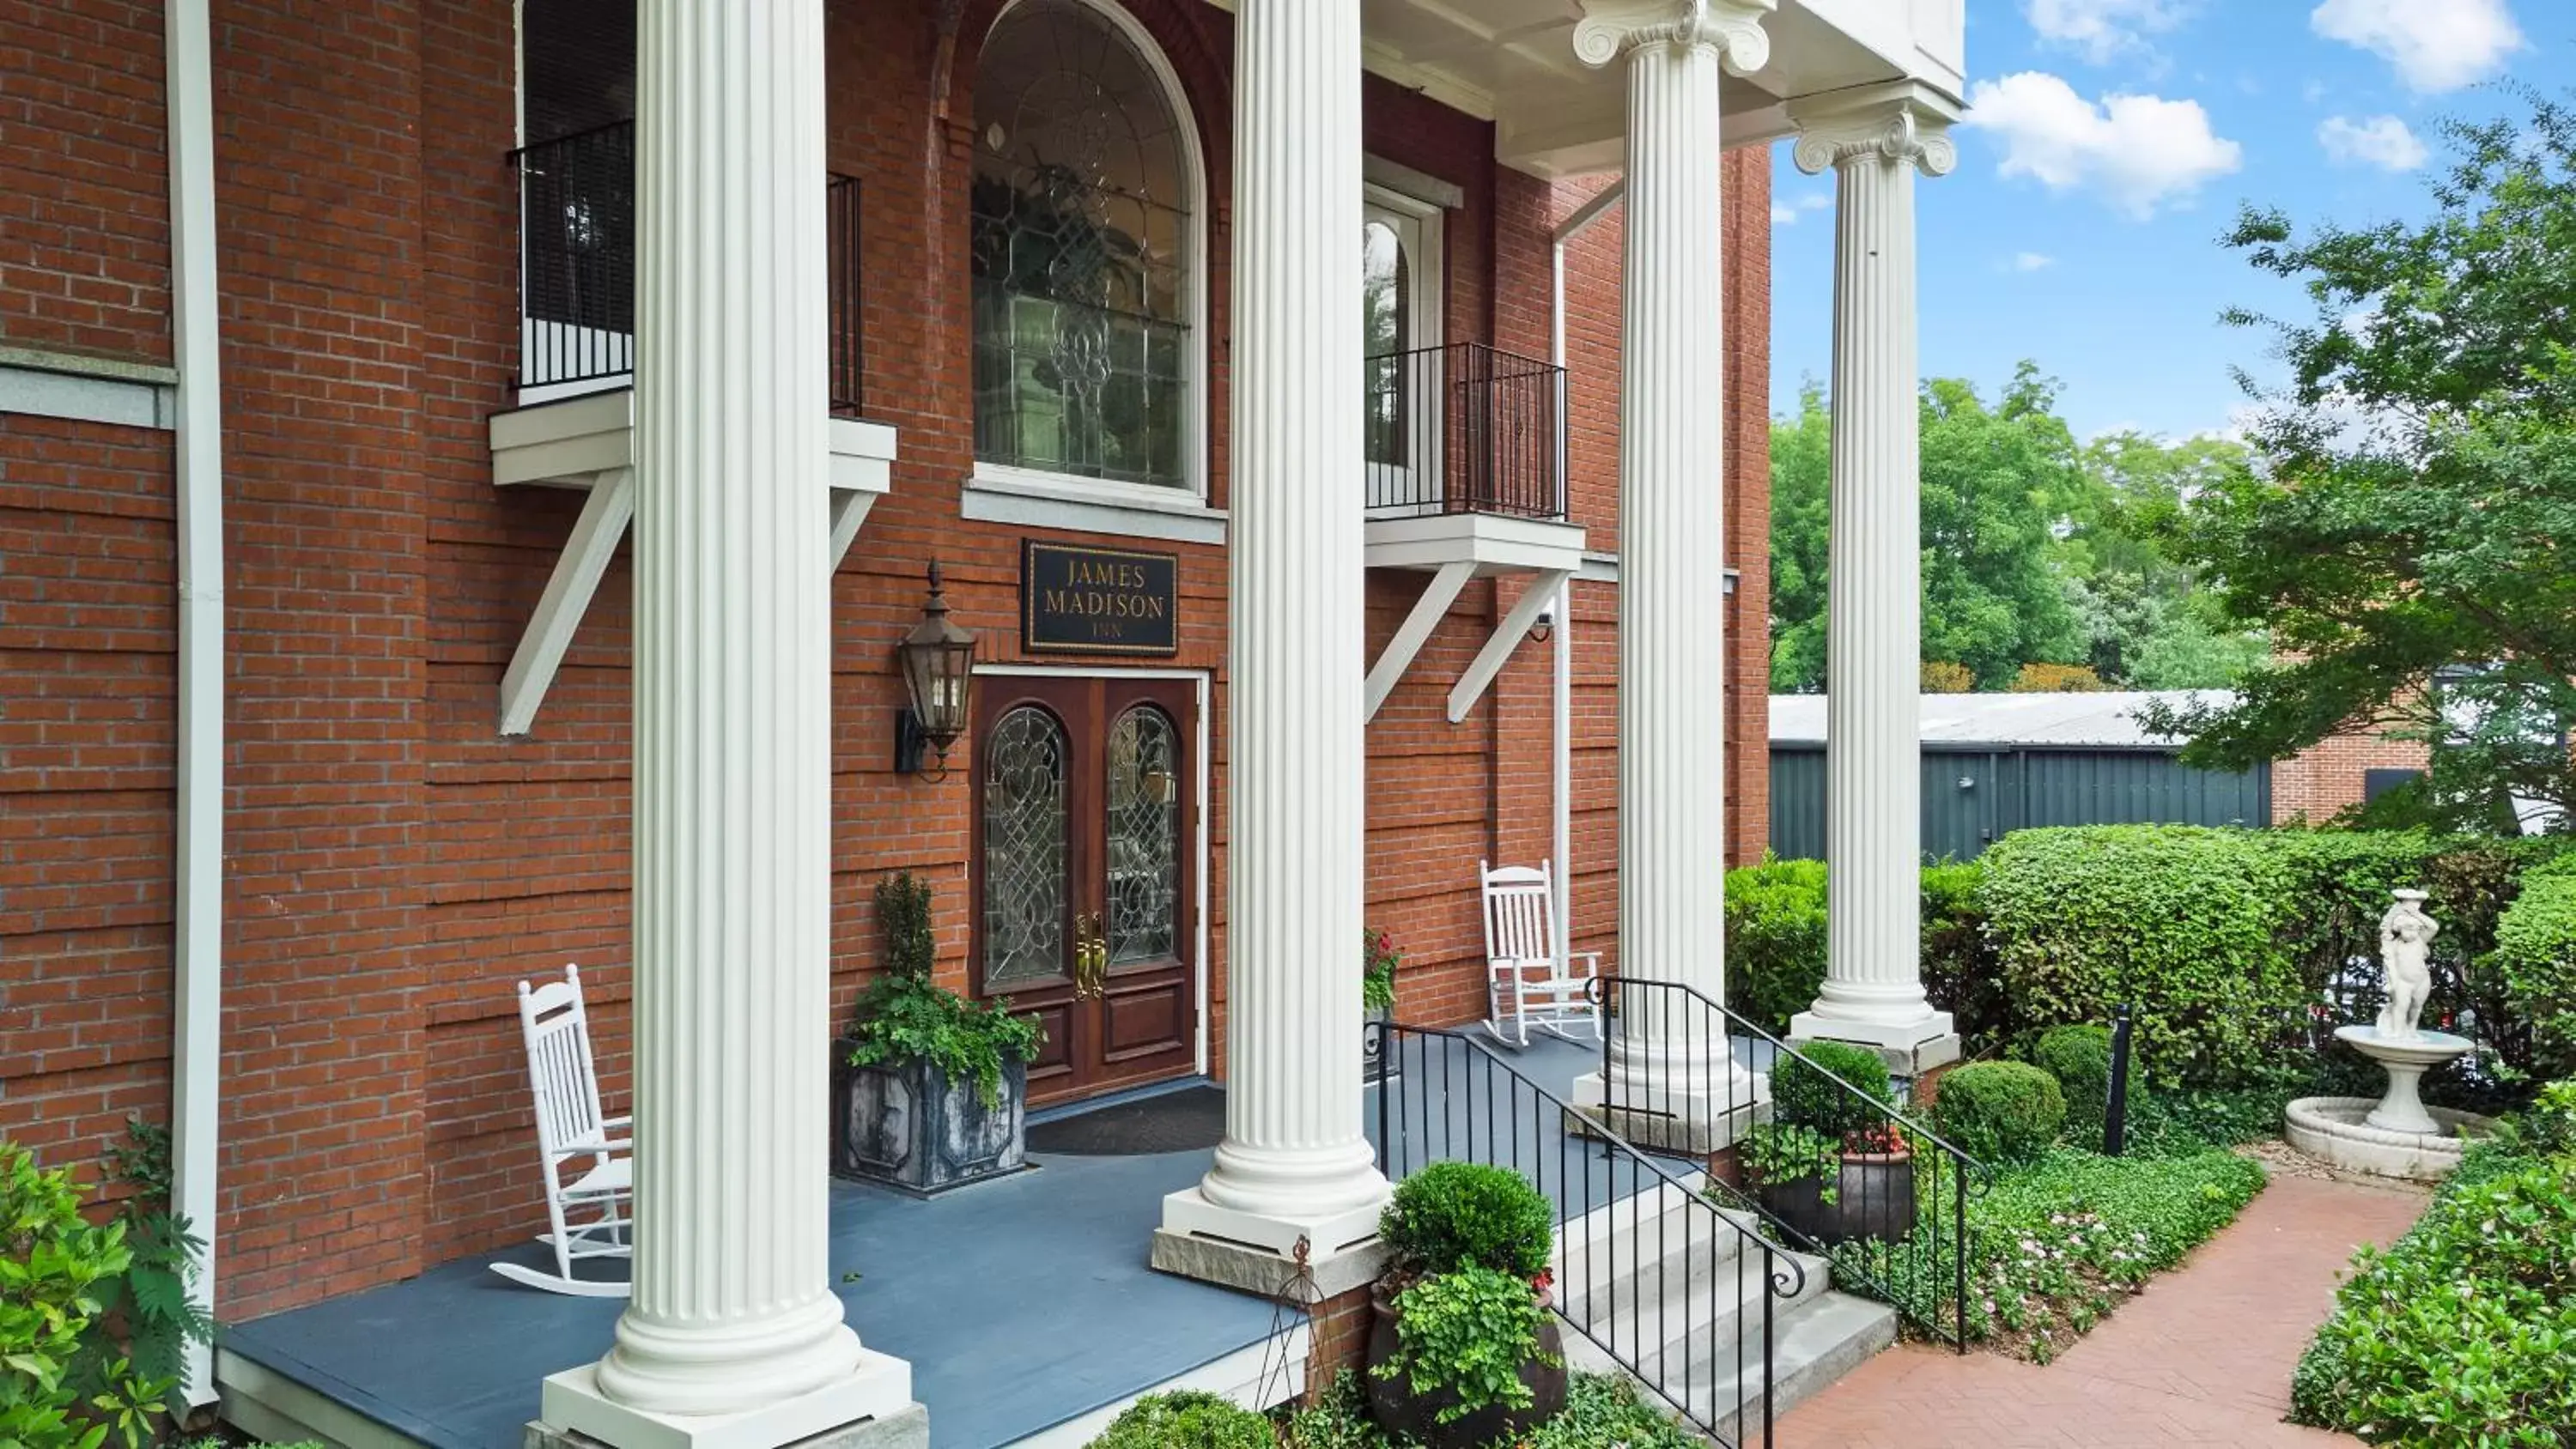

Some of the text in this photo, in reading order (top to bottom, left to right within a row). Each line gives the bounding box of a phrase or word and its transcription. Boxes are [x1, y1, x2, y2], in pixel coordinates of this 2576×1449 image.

[1067, 560, 1145, 588] JAMES
[1044, 590, 1163, 619] MADISON
[1092, 621, 1124, 638] INN
